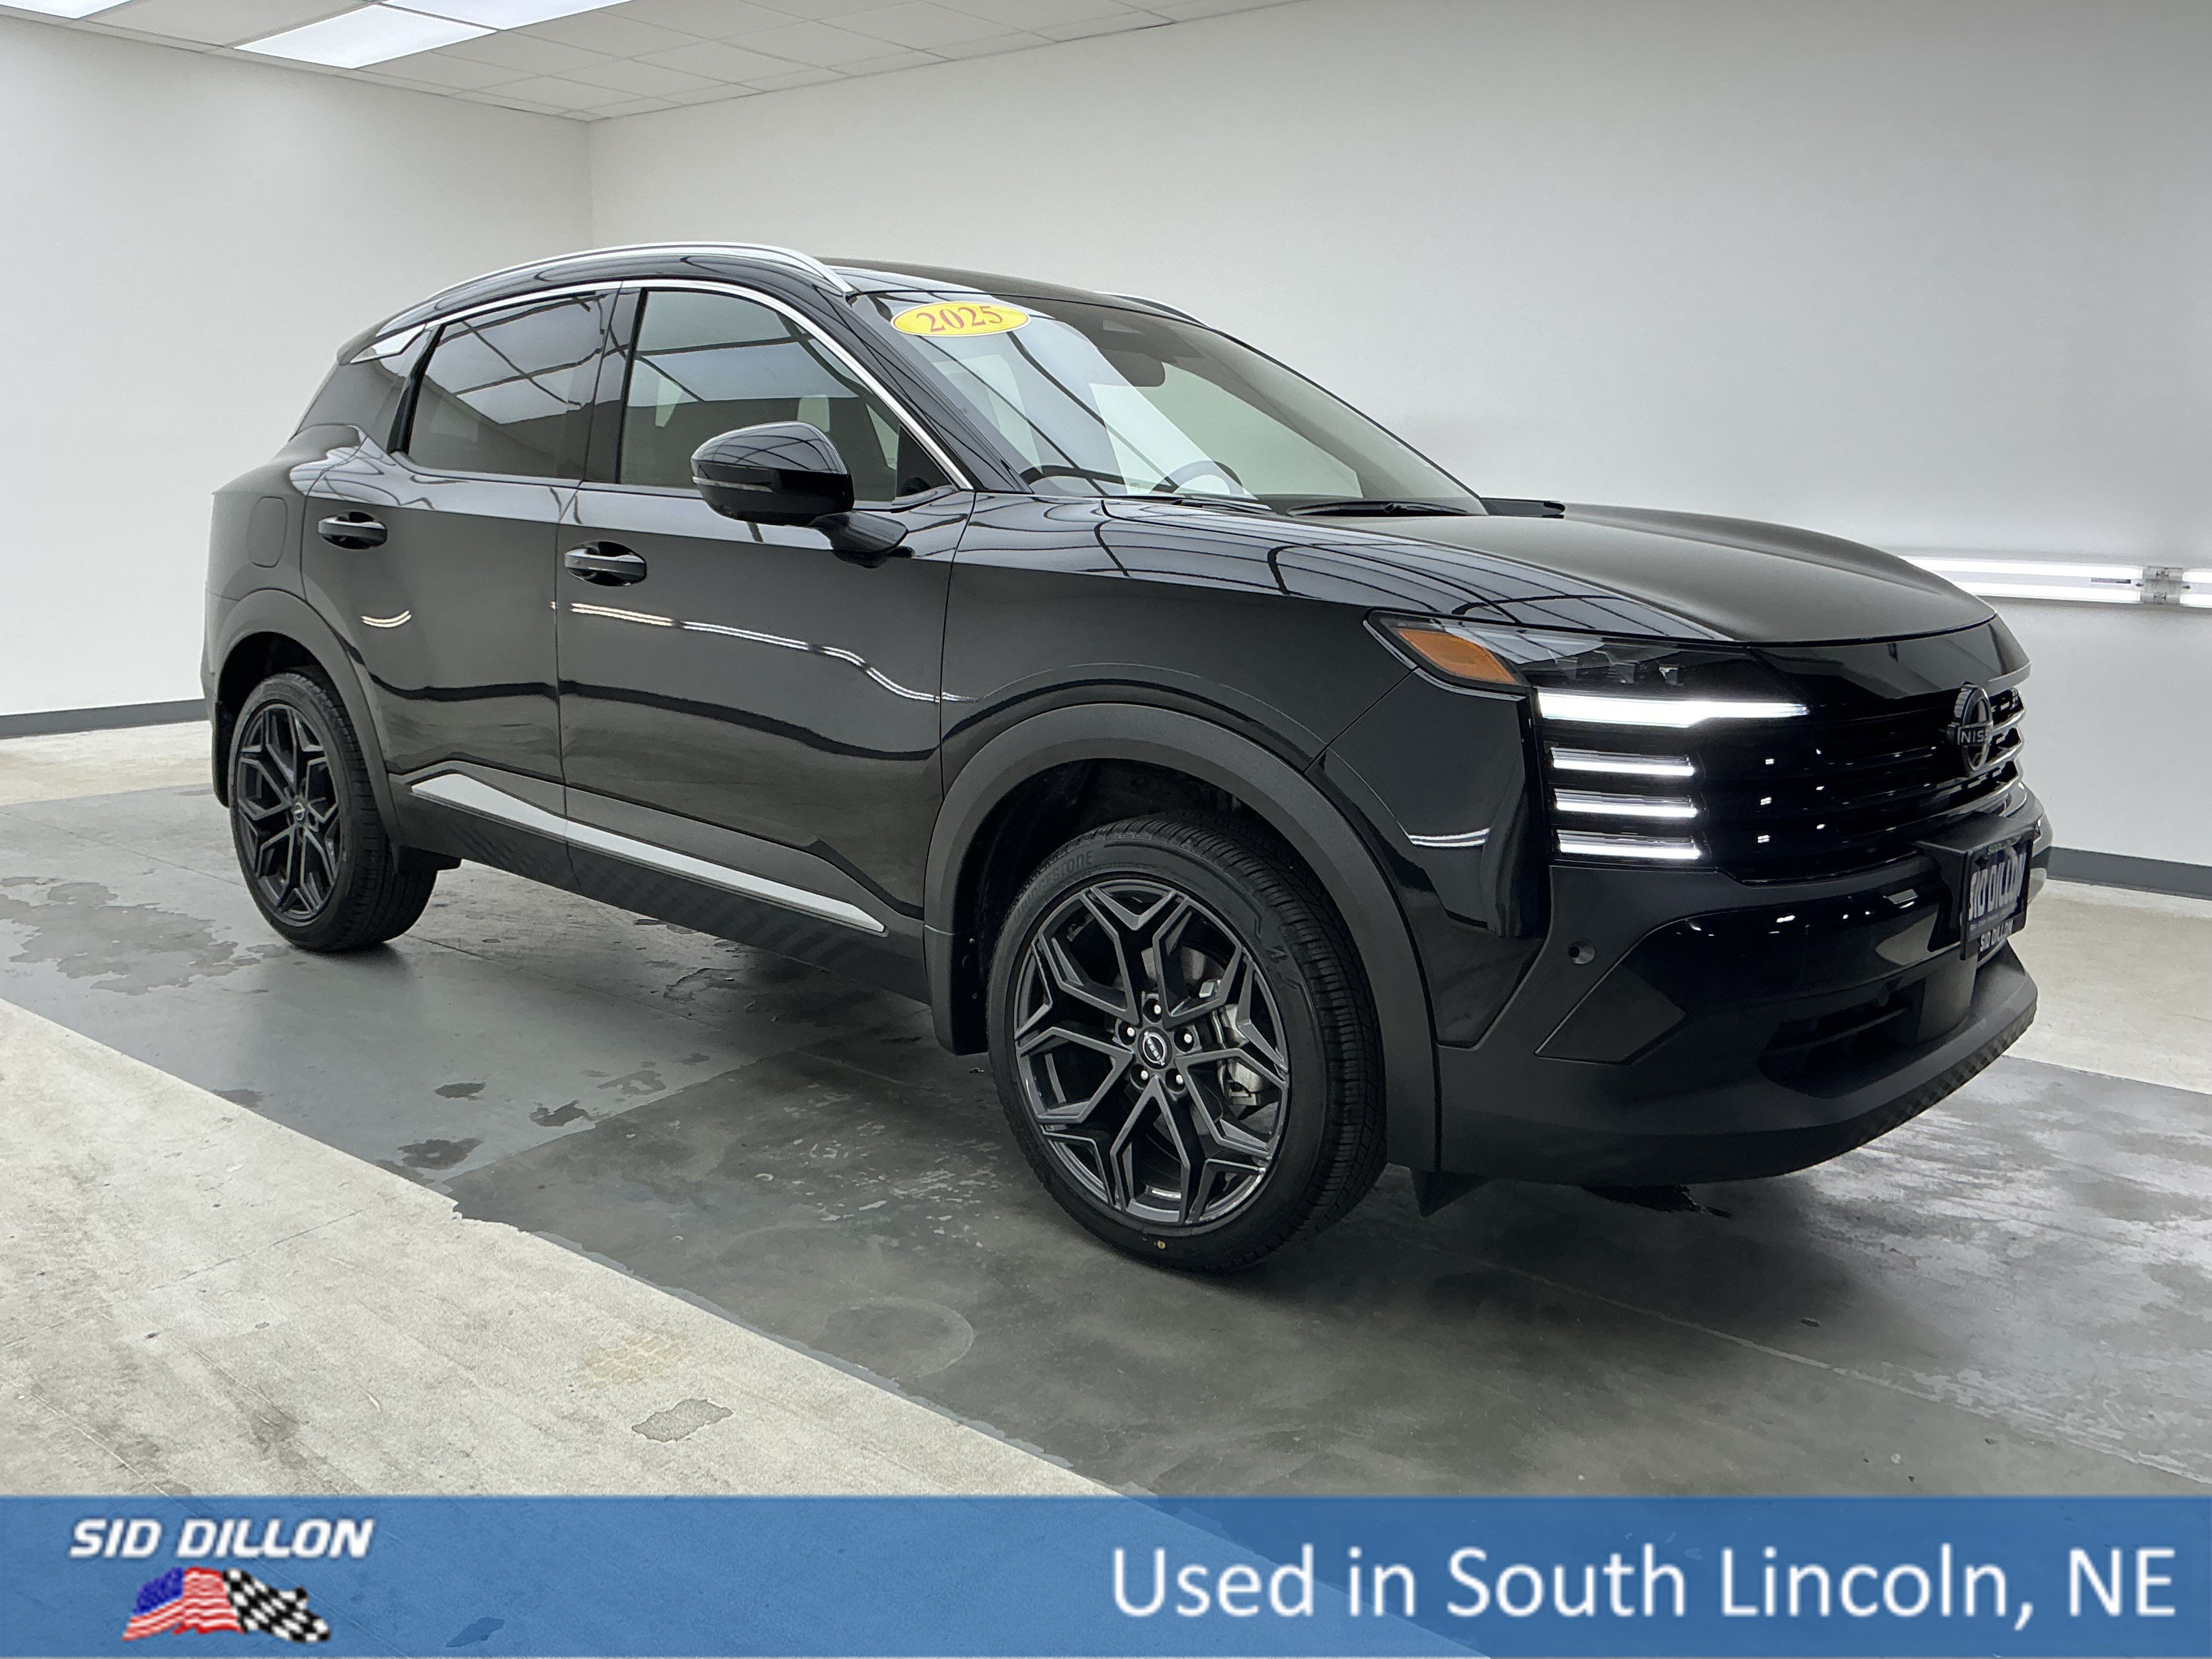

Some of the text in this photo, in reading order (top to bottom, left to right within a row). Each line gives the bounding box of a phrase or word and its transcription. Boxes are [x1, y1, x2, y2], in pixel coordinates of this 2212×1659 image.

[916, 305, 1003, 333] 2025
[1968, 868, 1988, 921] SID
[1987, 852, 2027, 913] DILLON
